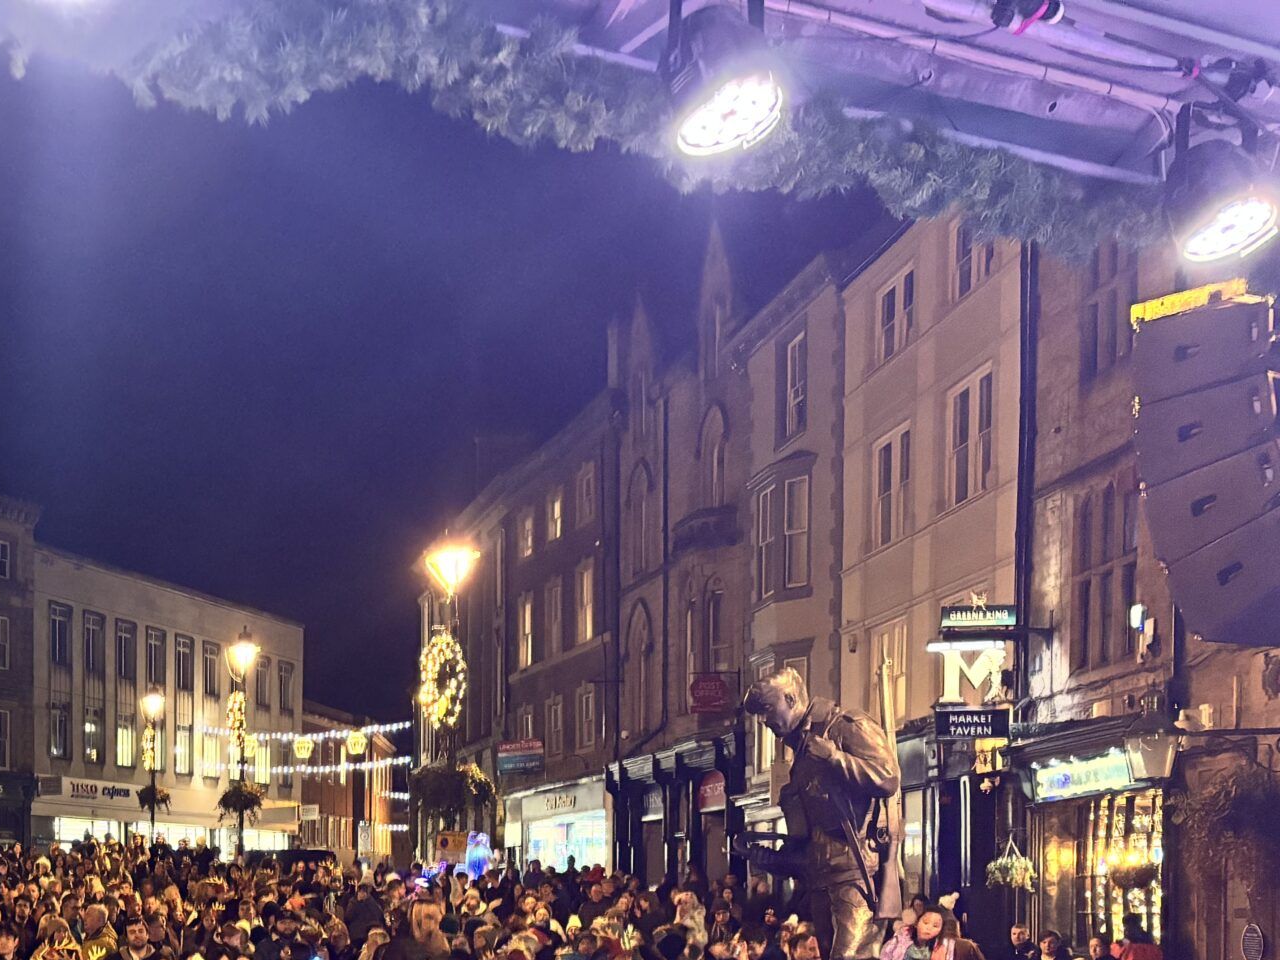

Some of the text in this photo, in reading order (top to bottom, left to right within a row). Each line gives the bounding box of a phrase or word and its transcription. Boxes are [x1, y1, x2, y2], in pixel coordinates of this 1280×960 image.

[986, 609, 1009, 620] KING
[698, 681, 721, 690] POST
[949, 714, 993, 724] MARKET
[949, 726, 993, 736] TAVERN
